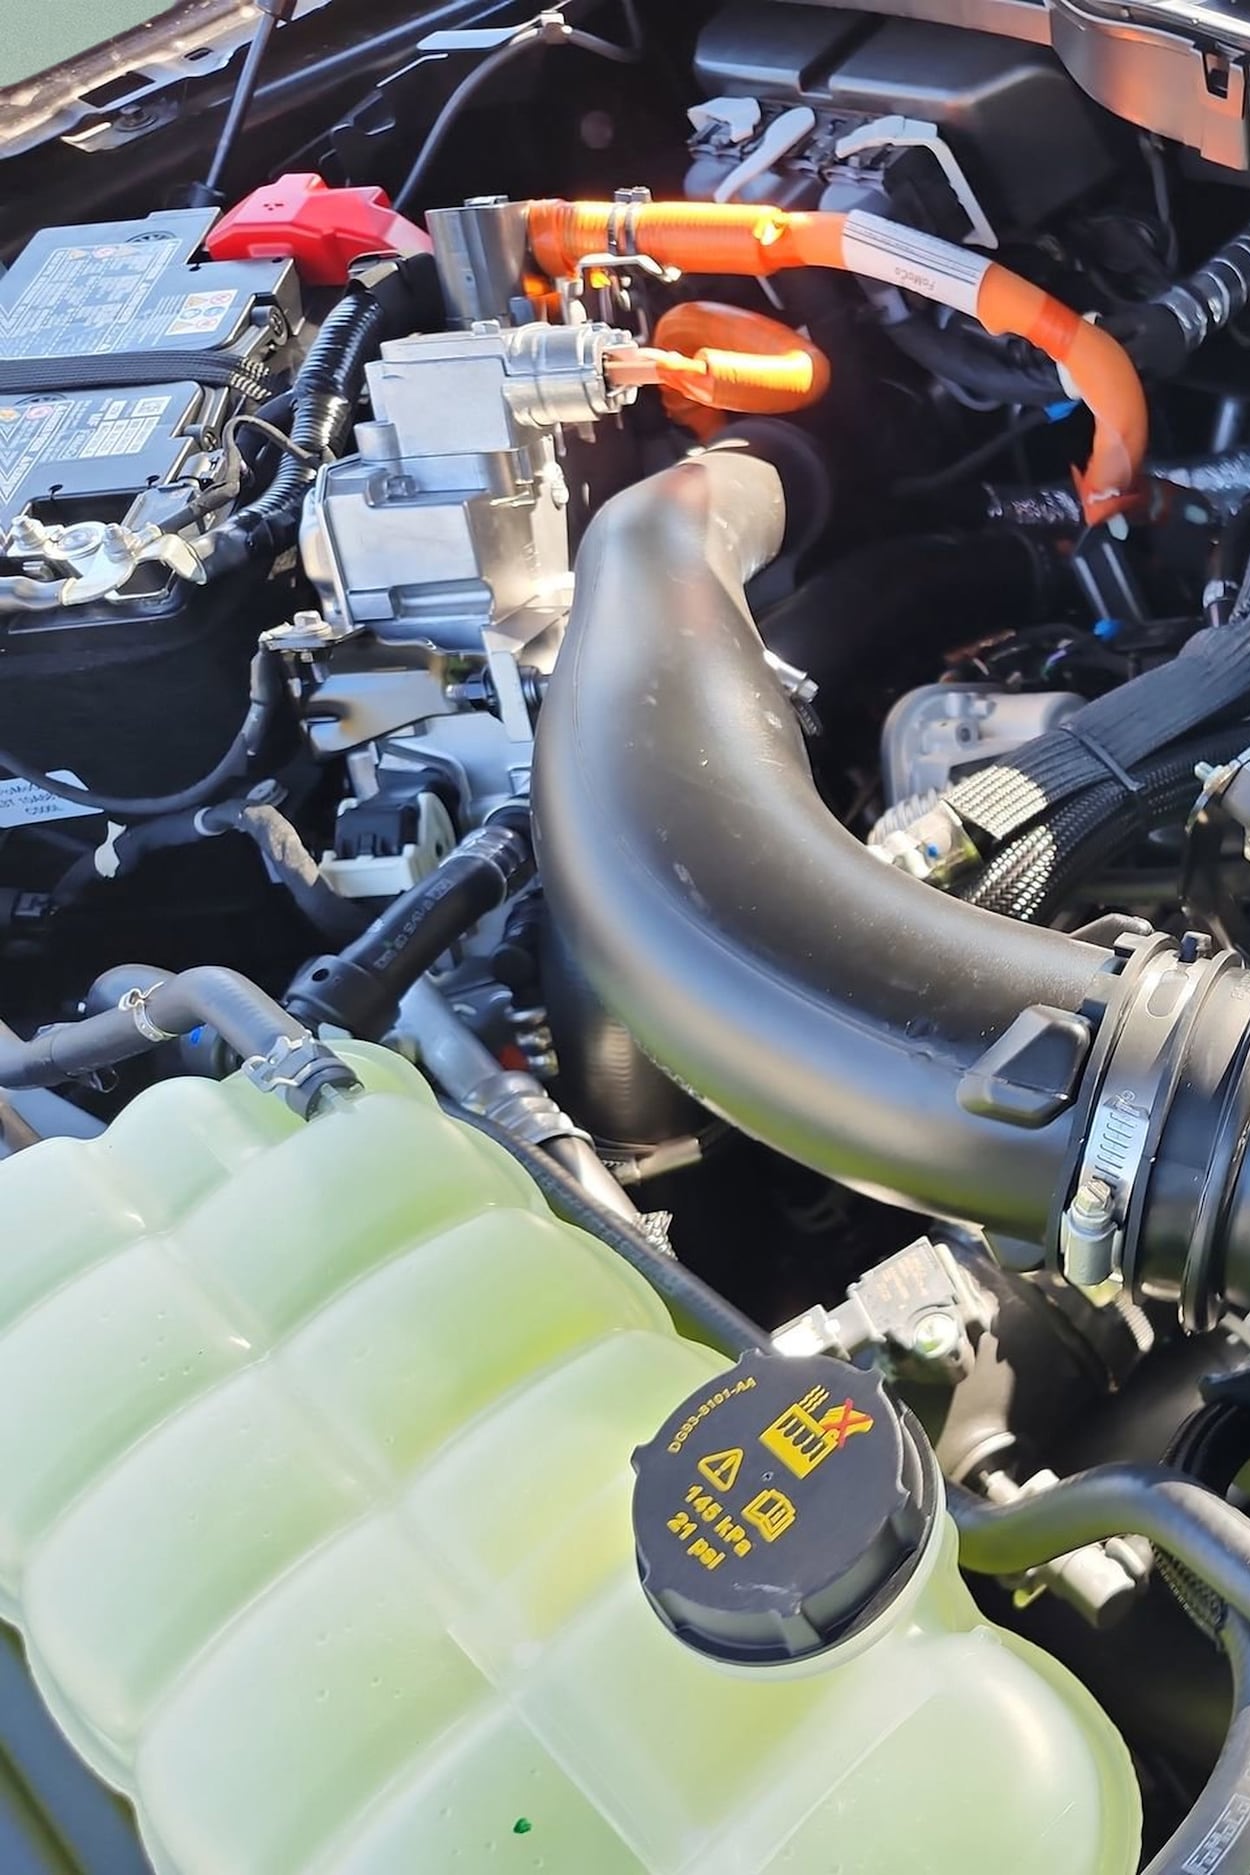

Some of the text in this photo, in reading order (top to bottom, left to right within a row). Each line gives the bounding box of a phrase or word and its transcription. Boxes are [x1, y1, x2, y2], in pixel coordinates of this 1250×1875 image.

[895, 267, 936, 290] FoMoCo
[667, 1512, 726, 1570] 21 psi
[684, 1485, 753, 1557] 145 kPa
